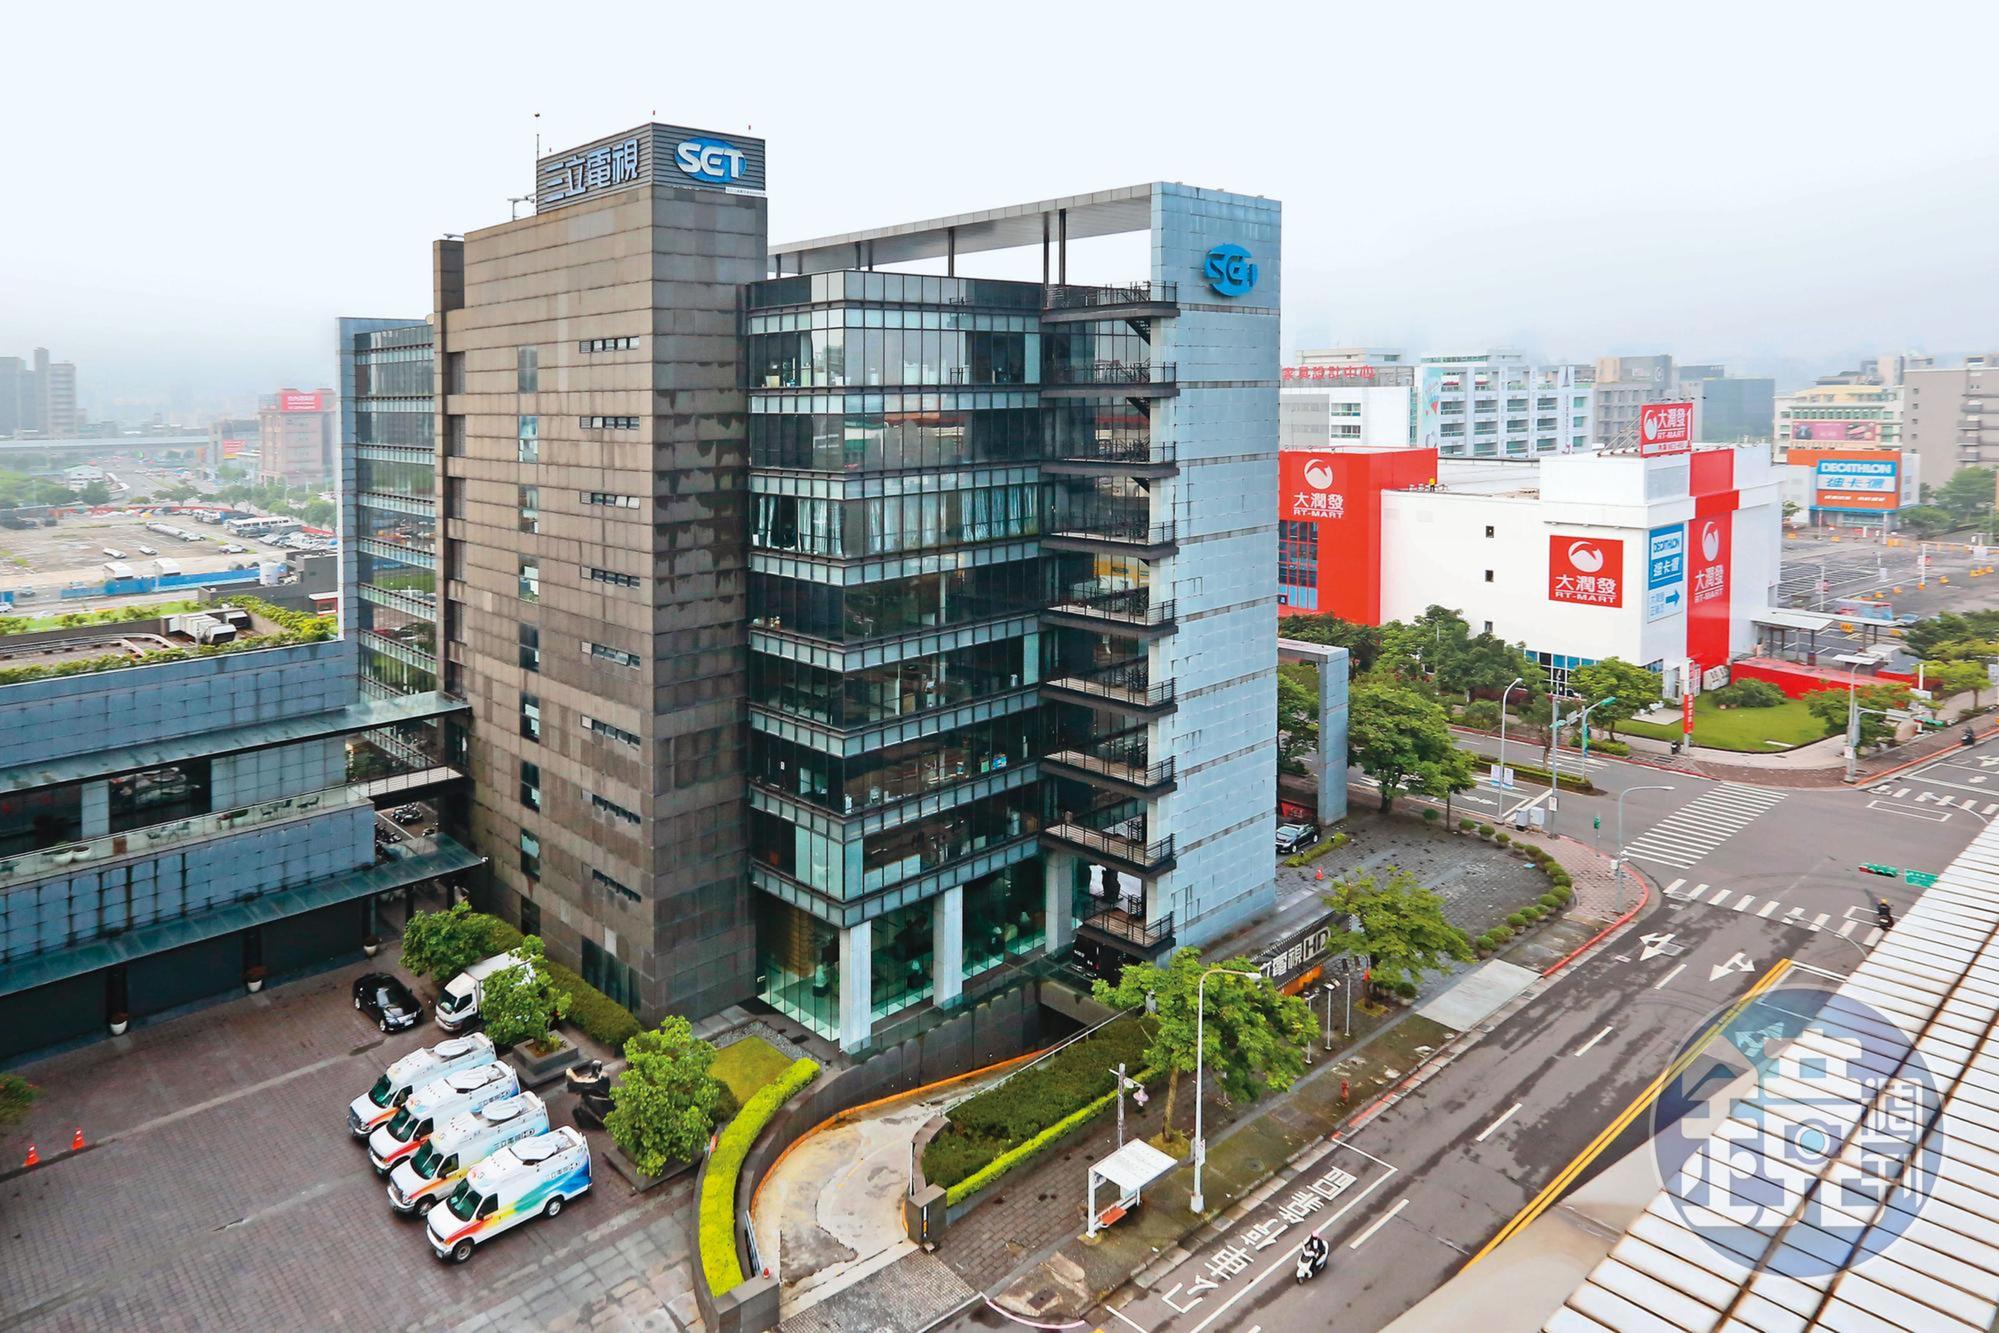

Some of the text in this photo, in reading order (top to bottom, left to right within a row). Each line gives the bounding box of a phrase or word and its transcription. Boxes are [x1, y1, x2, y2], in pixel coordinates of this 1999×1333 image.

[677, 141, 745, 178] SET
[544, 138, 639, 203] 三立電視
[1658, 408, 1686, 428] 大潤發
[1821, 462, 1892, 474] DECATHLON
[1294, 492, 1344, 511] 大潤發
[1293, 509, 1343, 518] RT-MART
[1555, 574, 1617, 596] 大潤發
[1695, 565, 1724, 592] 大潤發
[1555, 592, 1616, 603] RT-MART
[1161, 1166, 1358, 1314] 公車停靠區
